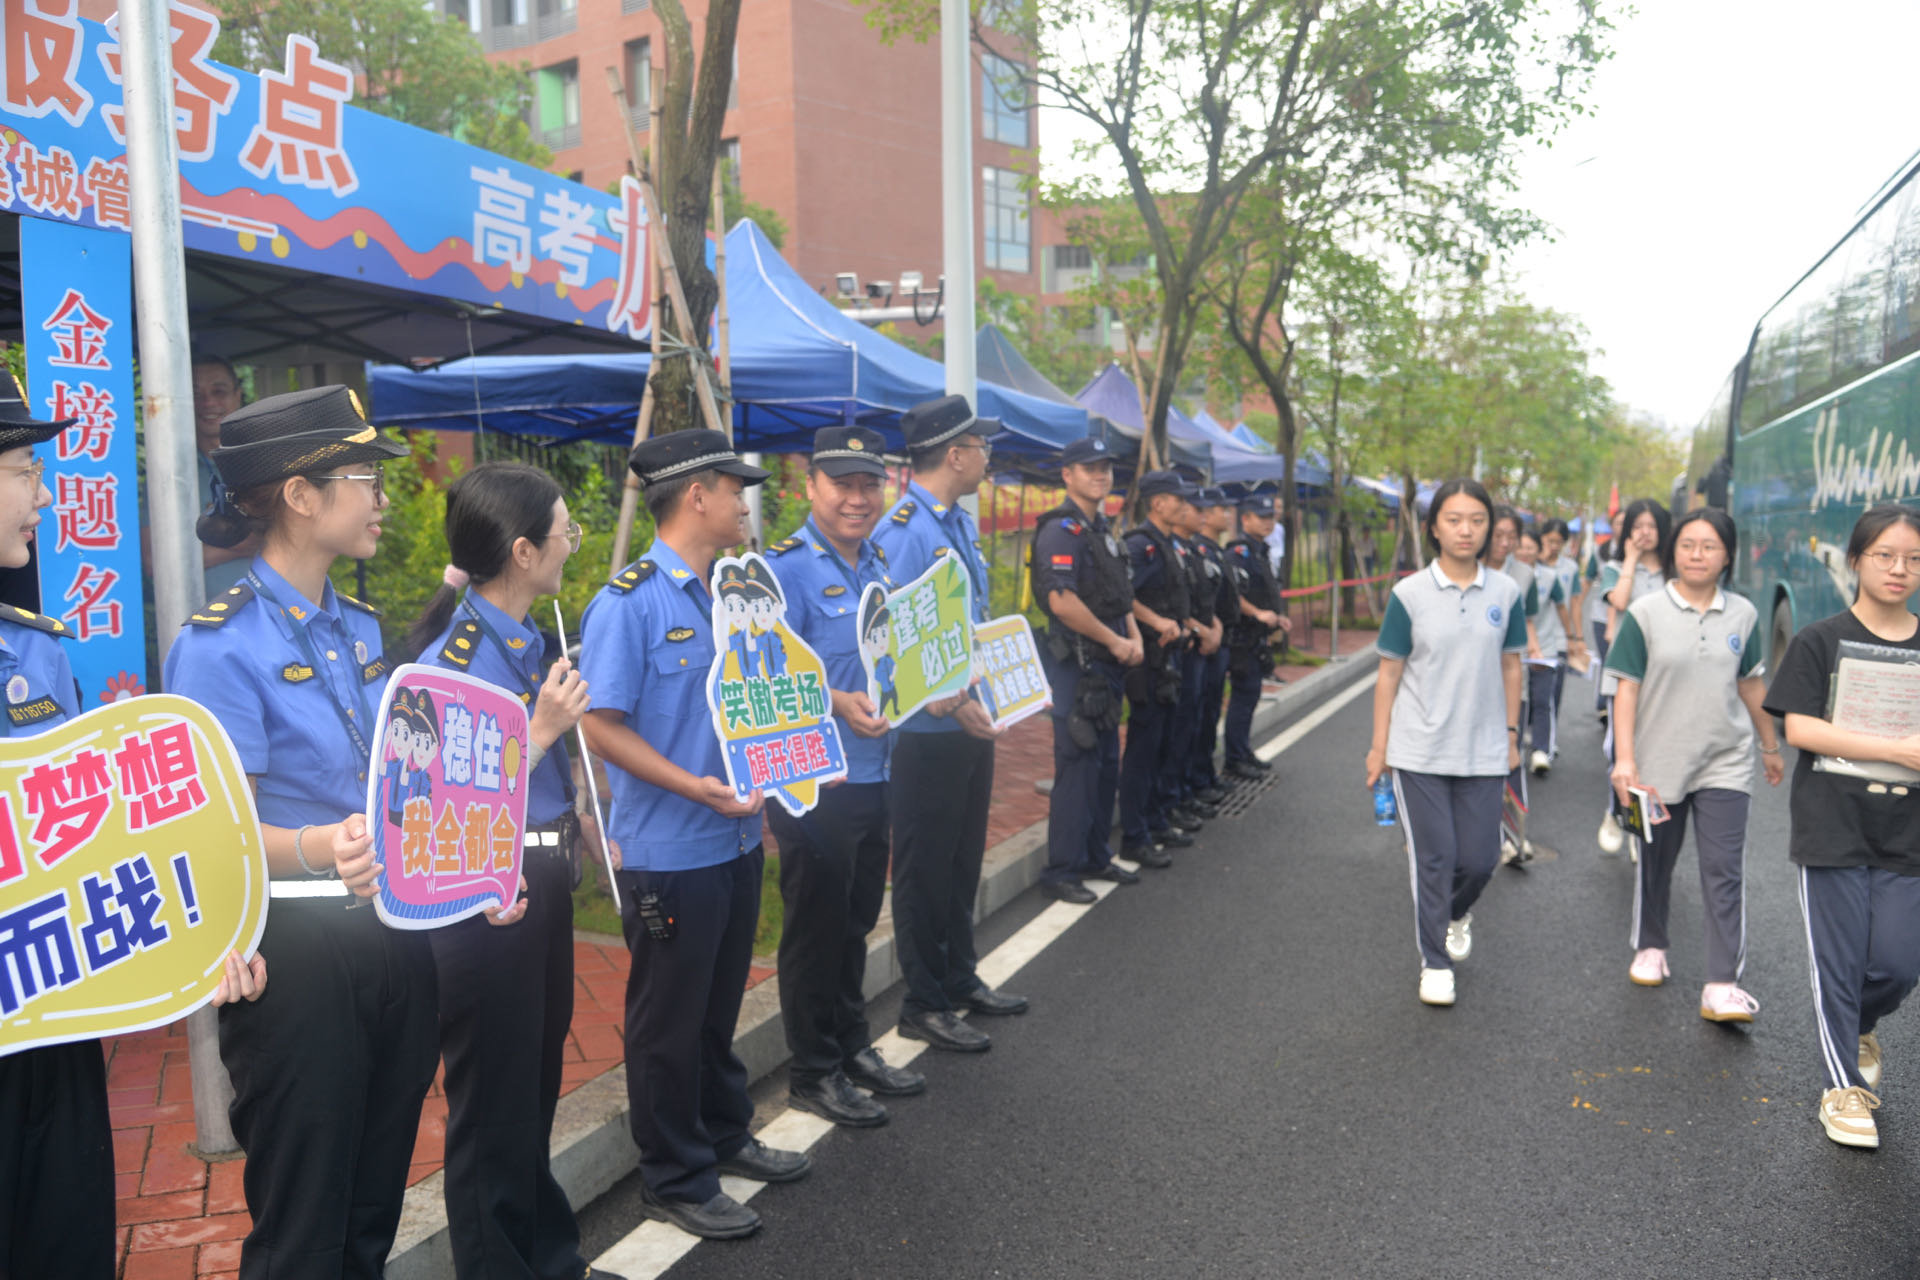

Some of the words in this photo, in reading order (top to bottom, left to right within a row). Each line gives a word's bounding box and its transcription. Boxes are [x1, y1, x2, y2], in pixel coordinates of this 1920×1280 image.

[0, 143, 132, 226] 城管
[44, 290, 121, 639] 金榜题名
[892, 580, 940, 658] 逢考
[921, 620, 969, 688] 必过
[719, 671, 826, 731] 笑傲考场
[994, 663, 1043, 709] 金榜题名
[443, 703, 503, 792] 稳住
[745, 729, 830, 786] 旗开得胜
[402, 797, 518, 878] 我全都会
